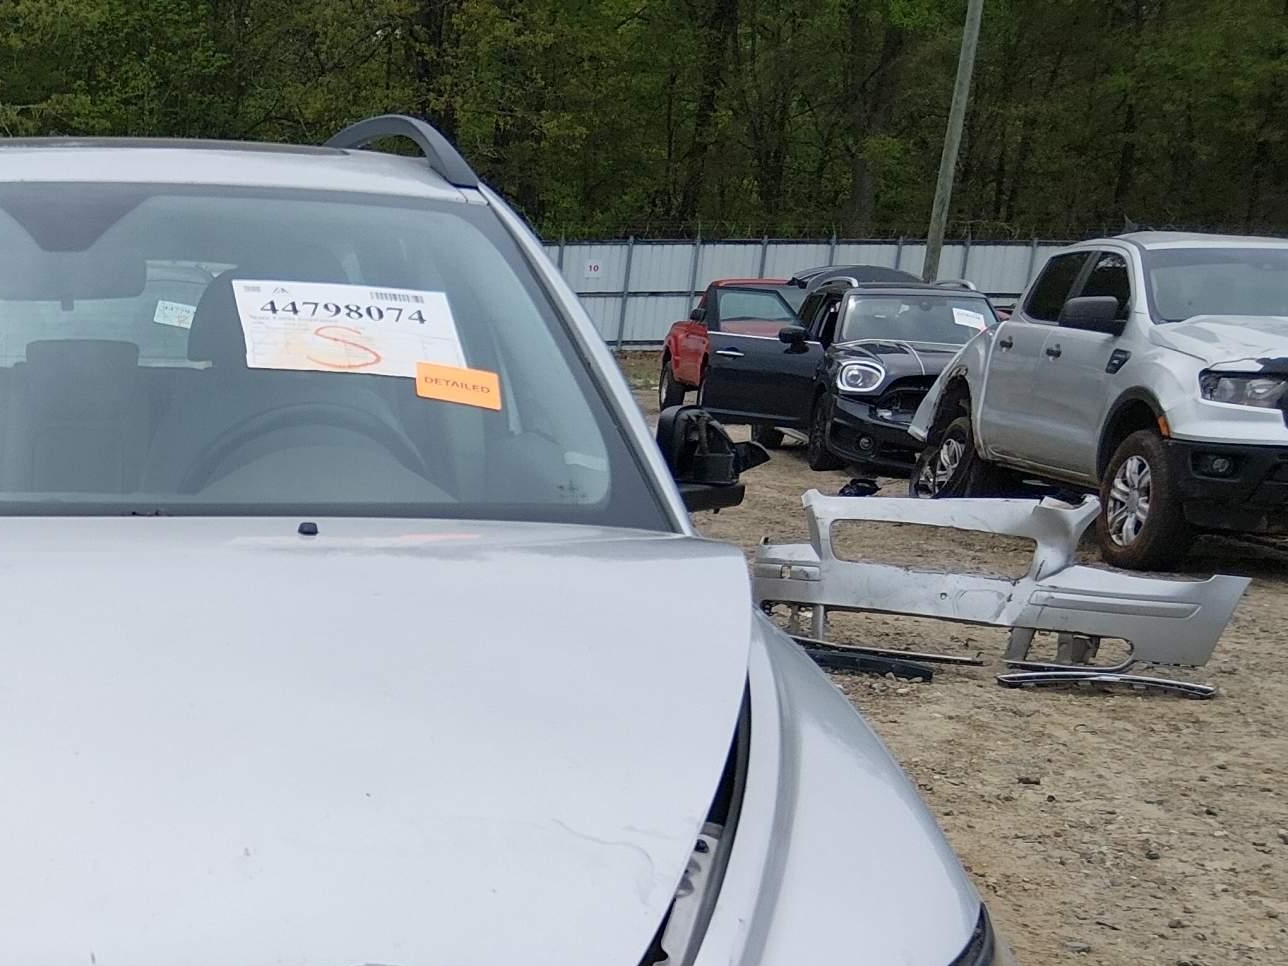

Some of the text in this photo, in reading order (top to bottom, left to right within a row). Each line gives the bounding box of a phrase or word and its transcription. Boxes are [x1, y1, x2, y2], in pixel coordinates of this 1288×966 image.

[588, 264, 600, 273] 10
[260, 299, 427, 325] 44798074
[424, 375, 490, 395] DETAILED
